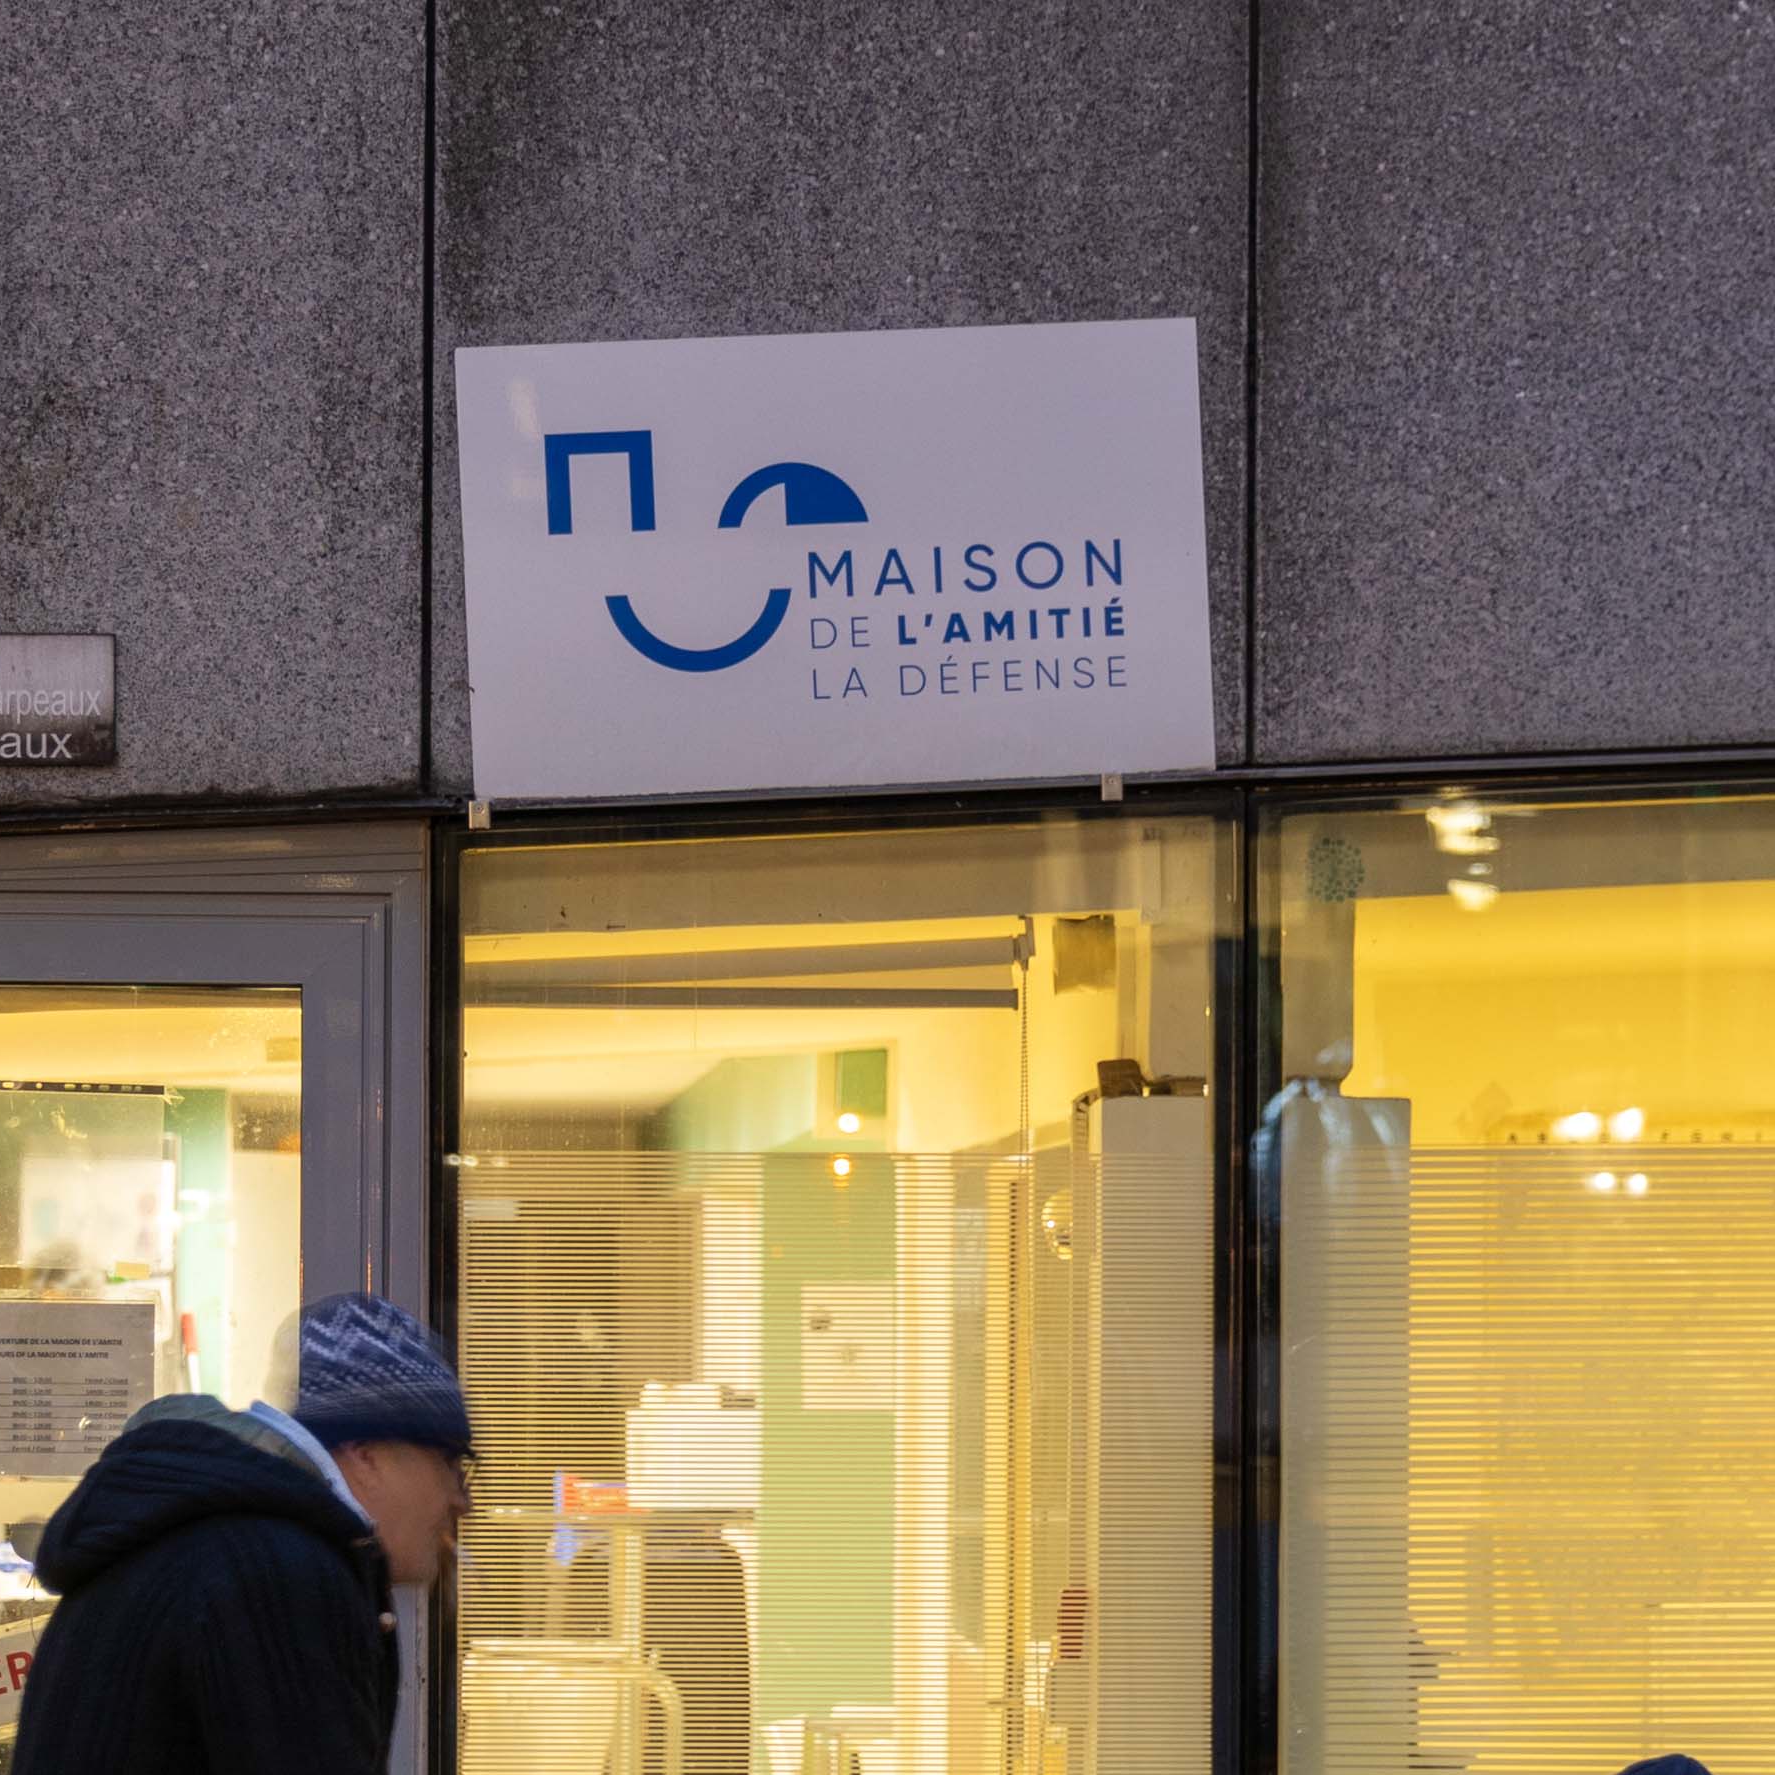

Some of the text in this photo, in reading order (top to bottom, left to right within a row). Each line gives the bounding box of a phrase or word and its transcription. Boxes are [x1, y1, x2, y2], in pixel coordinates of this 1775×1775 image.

[807, 538, 1123, 599] MAISON
[810, 598, 1126, 650] DE L'AMITIÉ
[812, 655, 1129, 701] LA DÉFENSE
